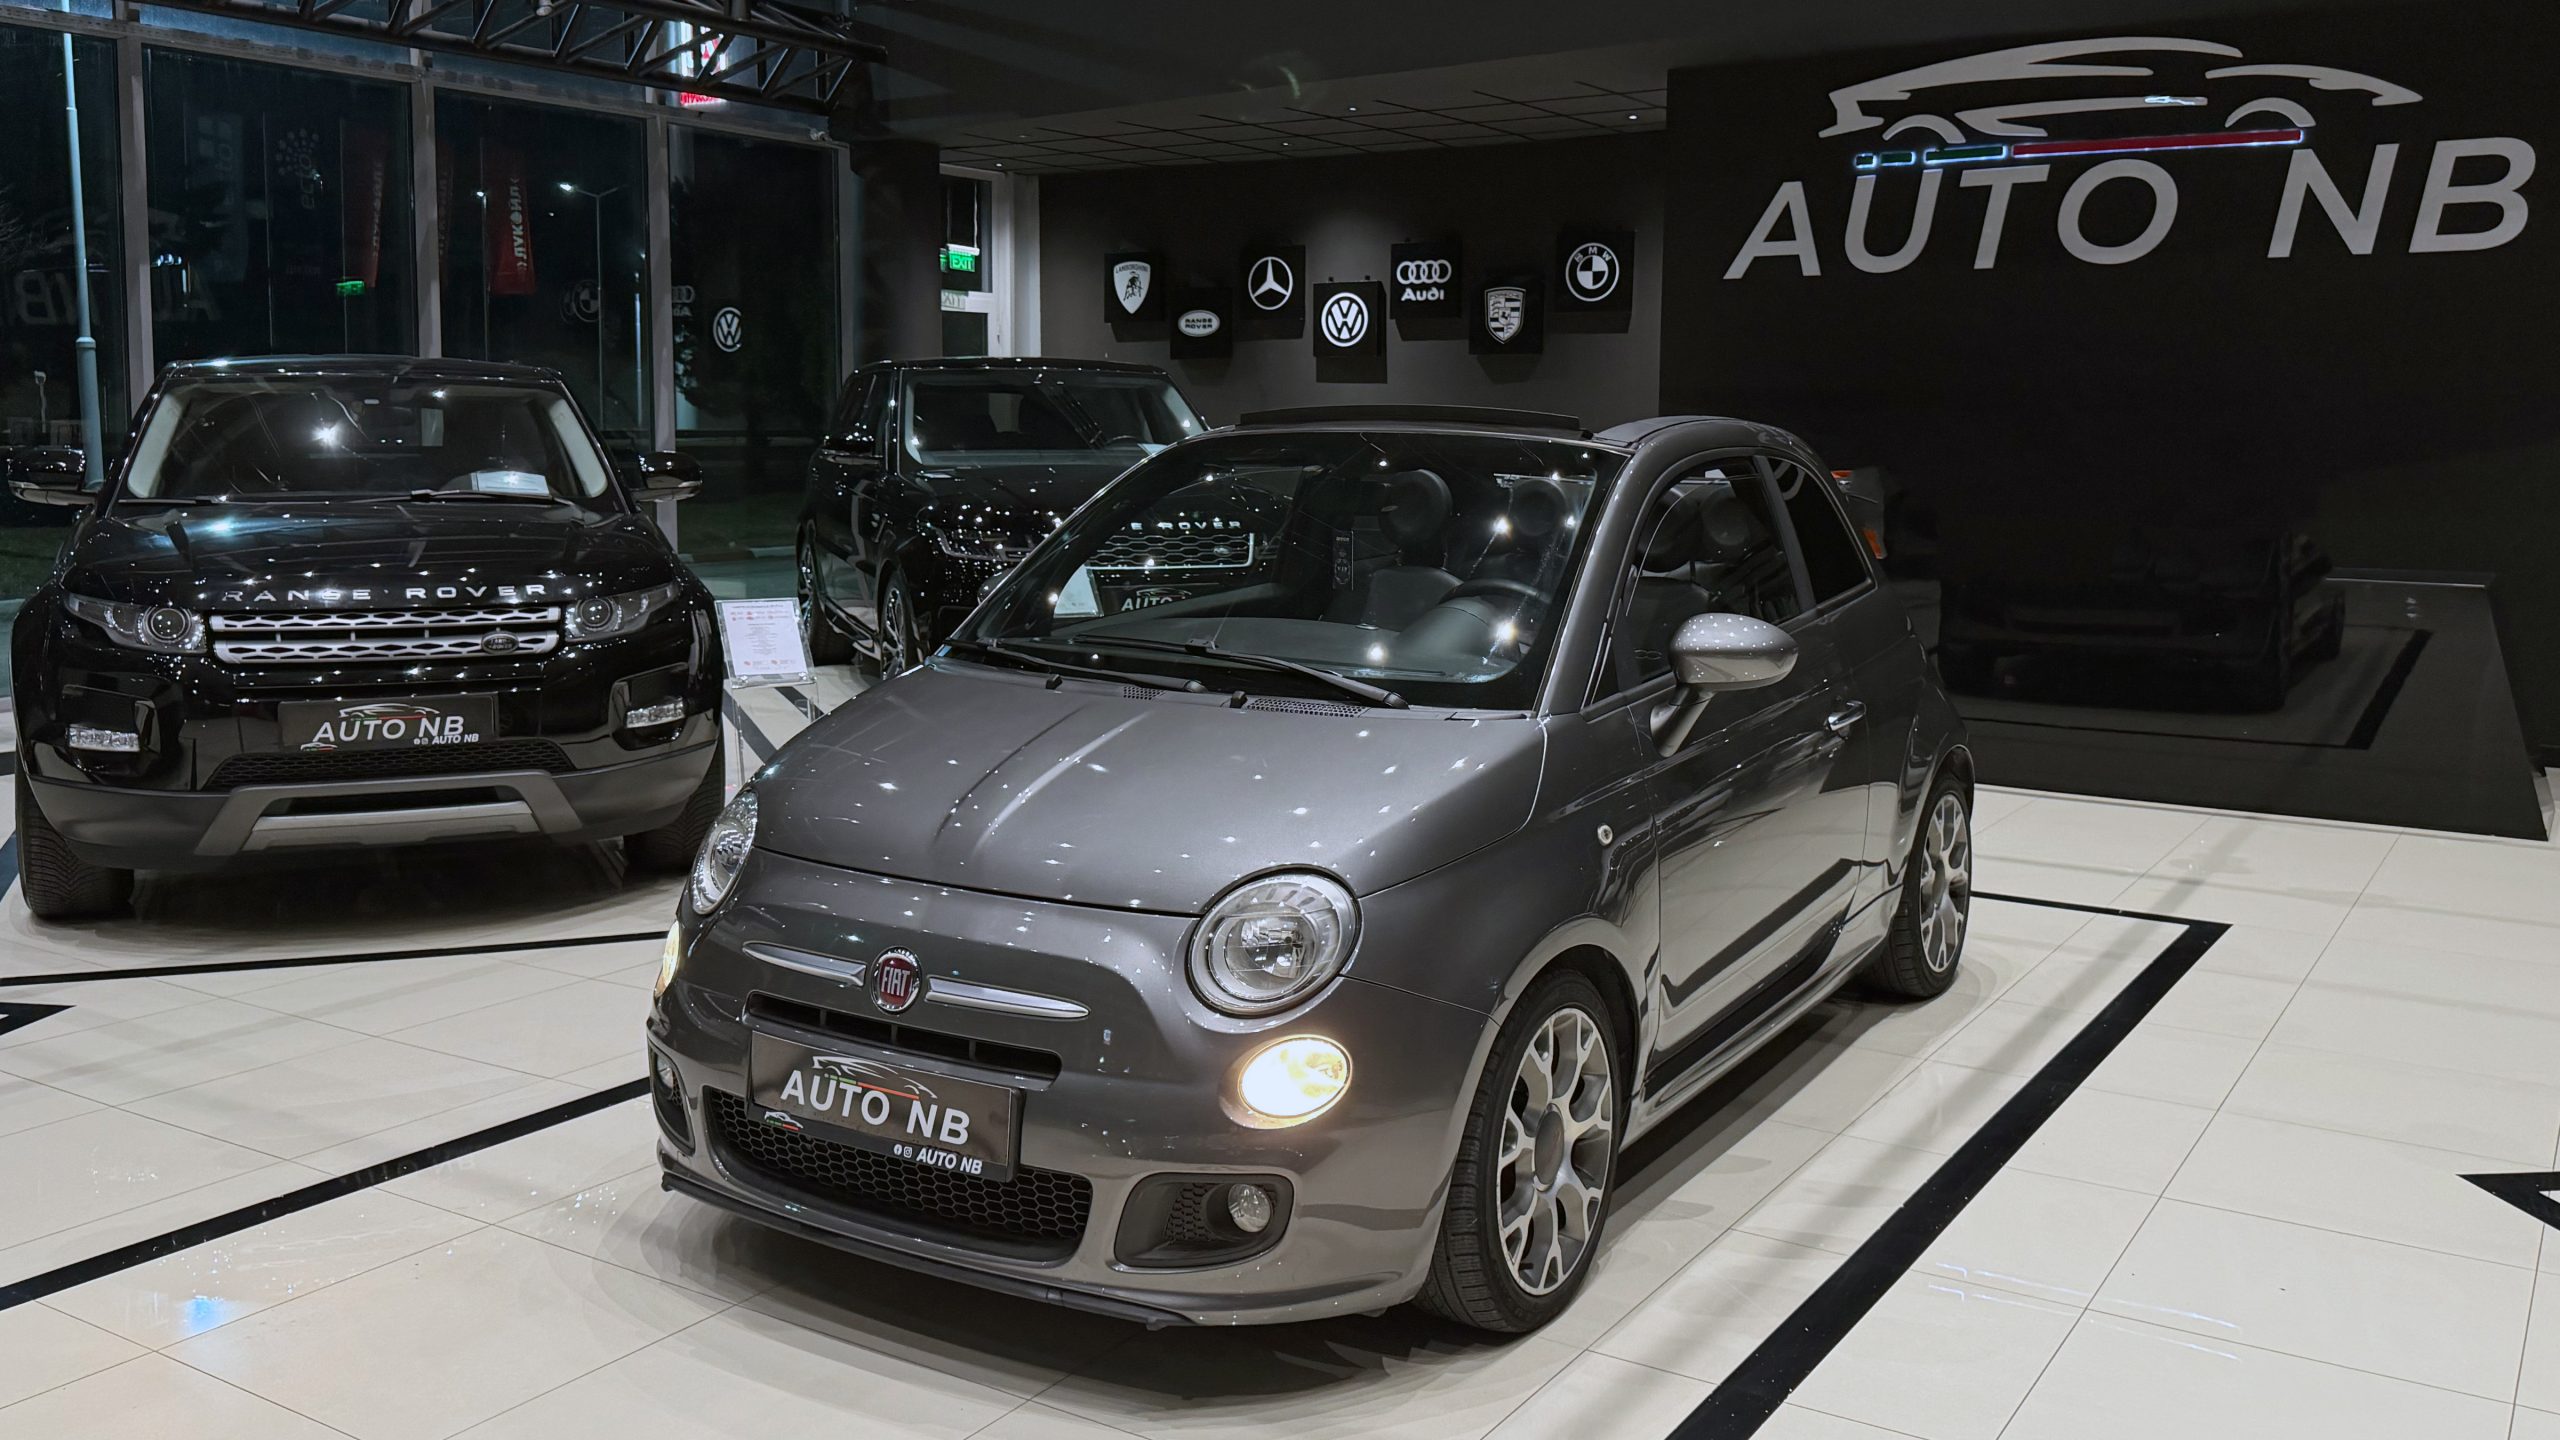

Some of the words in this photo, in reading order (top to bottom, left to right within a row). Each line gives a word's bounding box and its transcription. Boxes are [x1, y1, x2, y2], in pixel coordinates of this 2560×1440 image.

[1723, 158, 2179, 280] AUTO
[2267, 137, 2538, 259] NB
[953, 258, 973, 269] EXIT
[1574, 246, 1612, 263] BMW
[1401, 287, 1445, 302] Audi
[1158, 521, 1242, 531] ROVER
[223, 588, 371, 602] RANGE
[405, 583, 547, 600] ROVER
[312, 718, 406, 743] AUTO
[418, 715, 465, 738] NB
[432, 734, 462, 745] AUTO
[464, 732, 479, 743] NB
[881, 965, 911, 998] FIAT
[780, 1069, 890, 1126] AUTO
[906, 1099, 970, 1146] NB
[916, 1148, 957, 1170] AUTO
[960, 1157, 983, 1175] NB
